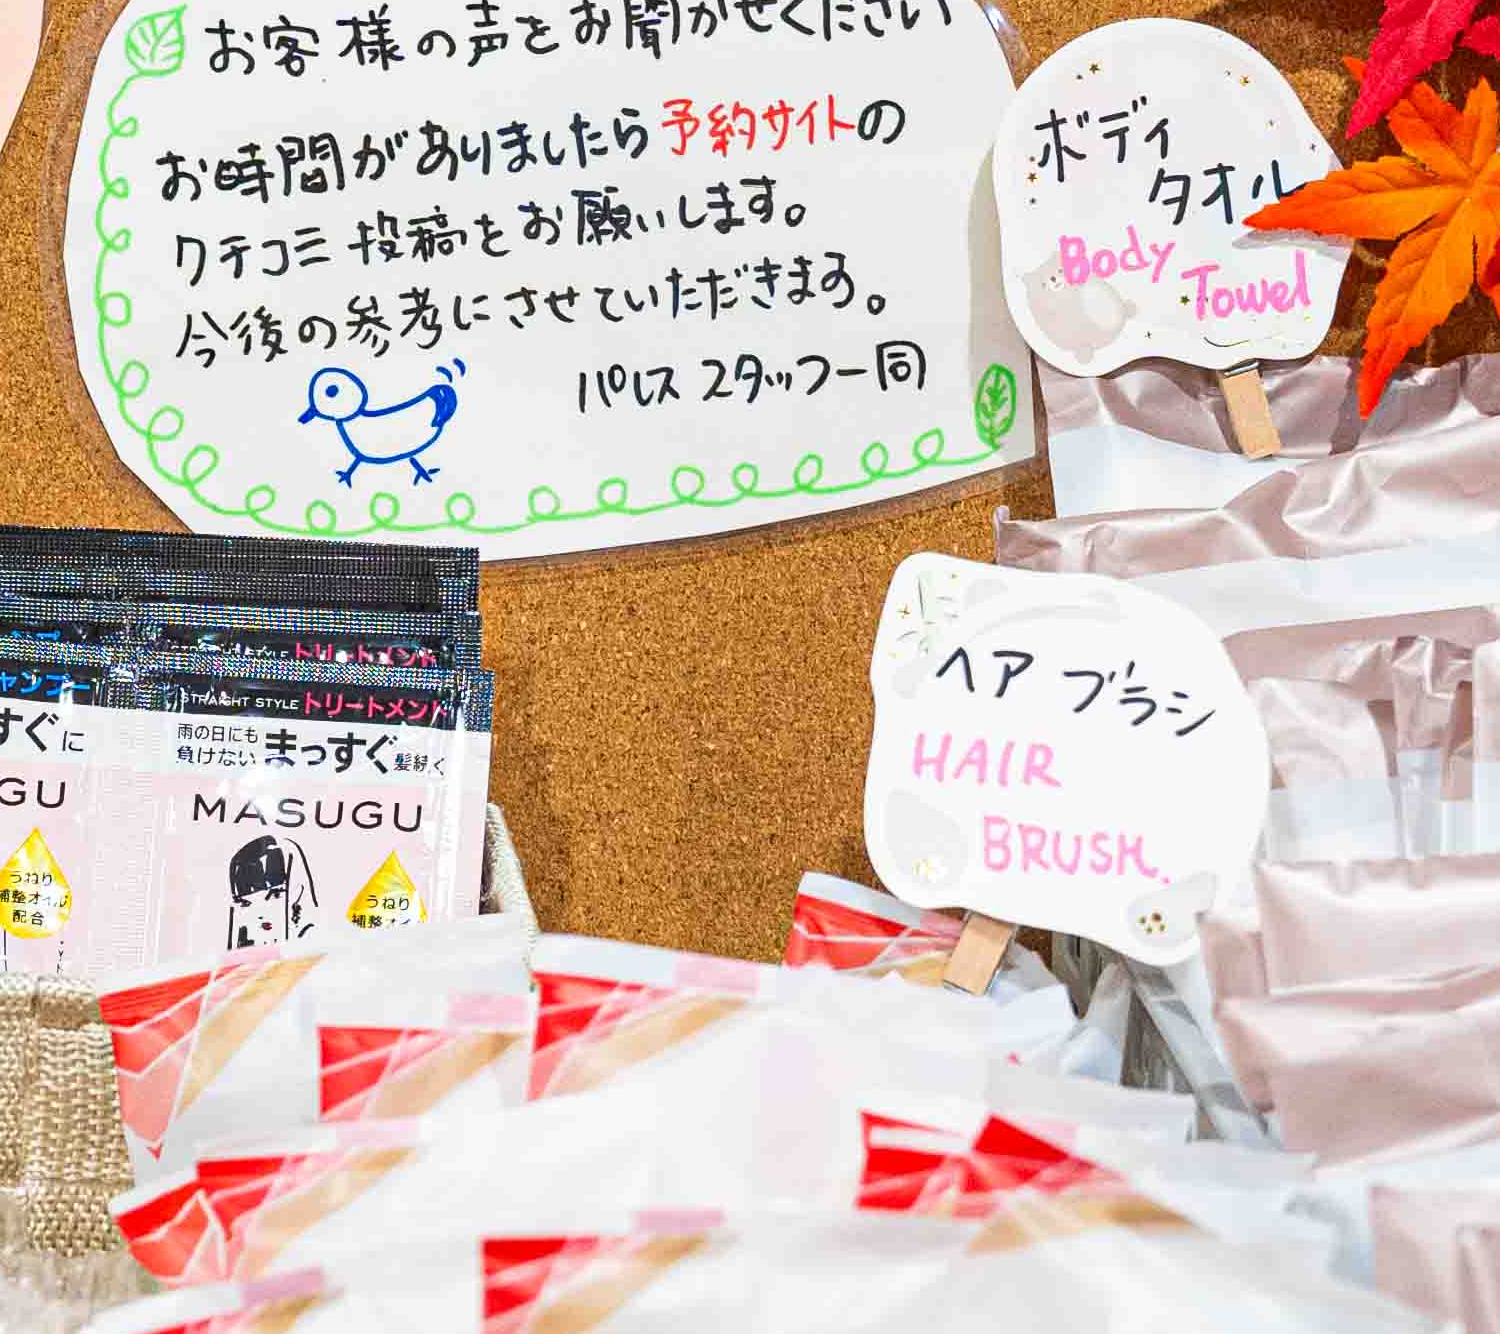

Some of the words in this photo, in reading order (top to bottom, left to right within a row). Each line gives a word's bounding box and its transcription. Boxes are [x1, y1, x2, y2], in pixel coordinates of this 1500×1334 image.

[1034, 96, 1169, 183] ボディ
[1149, 159, 1307, 225] タオル
[1058, 225, 1176, 285] Body
[1181, 250, 1311, 320] Towel
[174, 251, 888, 369] 今後の参考にさせていただきます。
[255, 697, 299, 710] STYLE
[304, 691, 448, 720] トリートメント
[177, 723, 258, 744] 雨の日にも
[176, 746, 256, 767] 負けない
[912, 732, 1062, 788] HAIR
[192, 793, 422, 832] MASUGU
[10, 872, 52, 886] うねり
[12, 909, 45, 926] 配合
[366, 895, 410, 911] うねり
